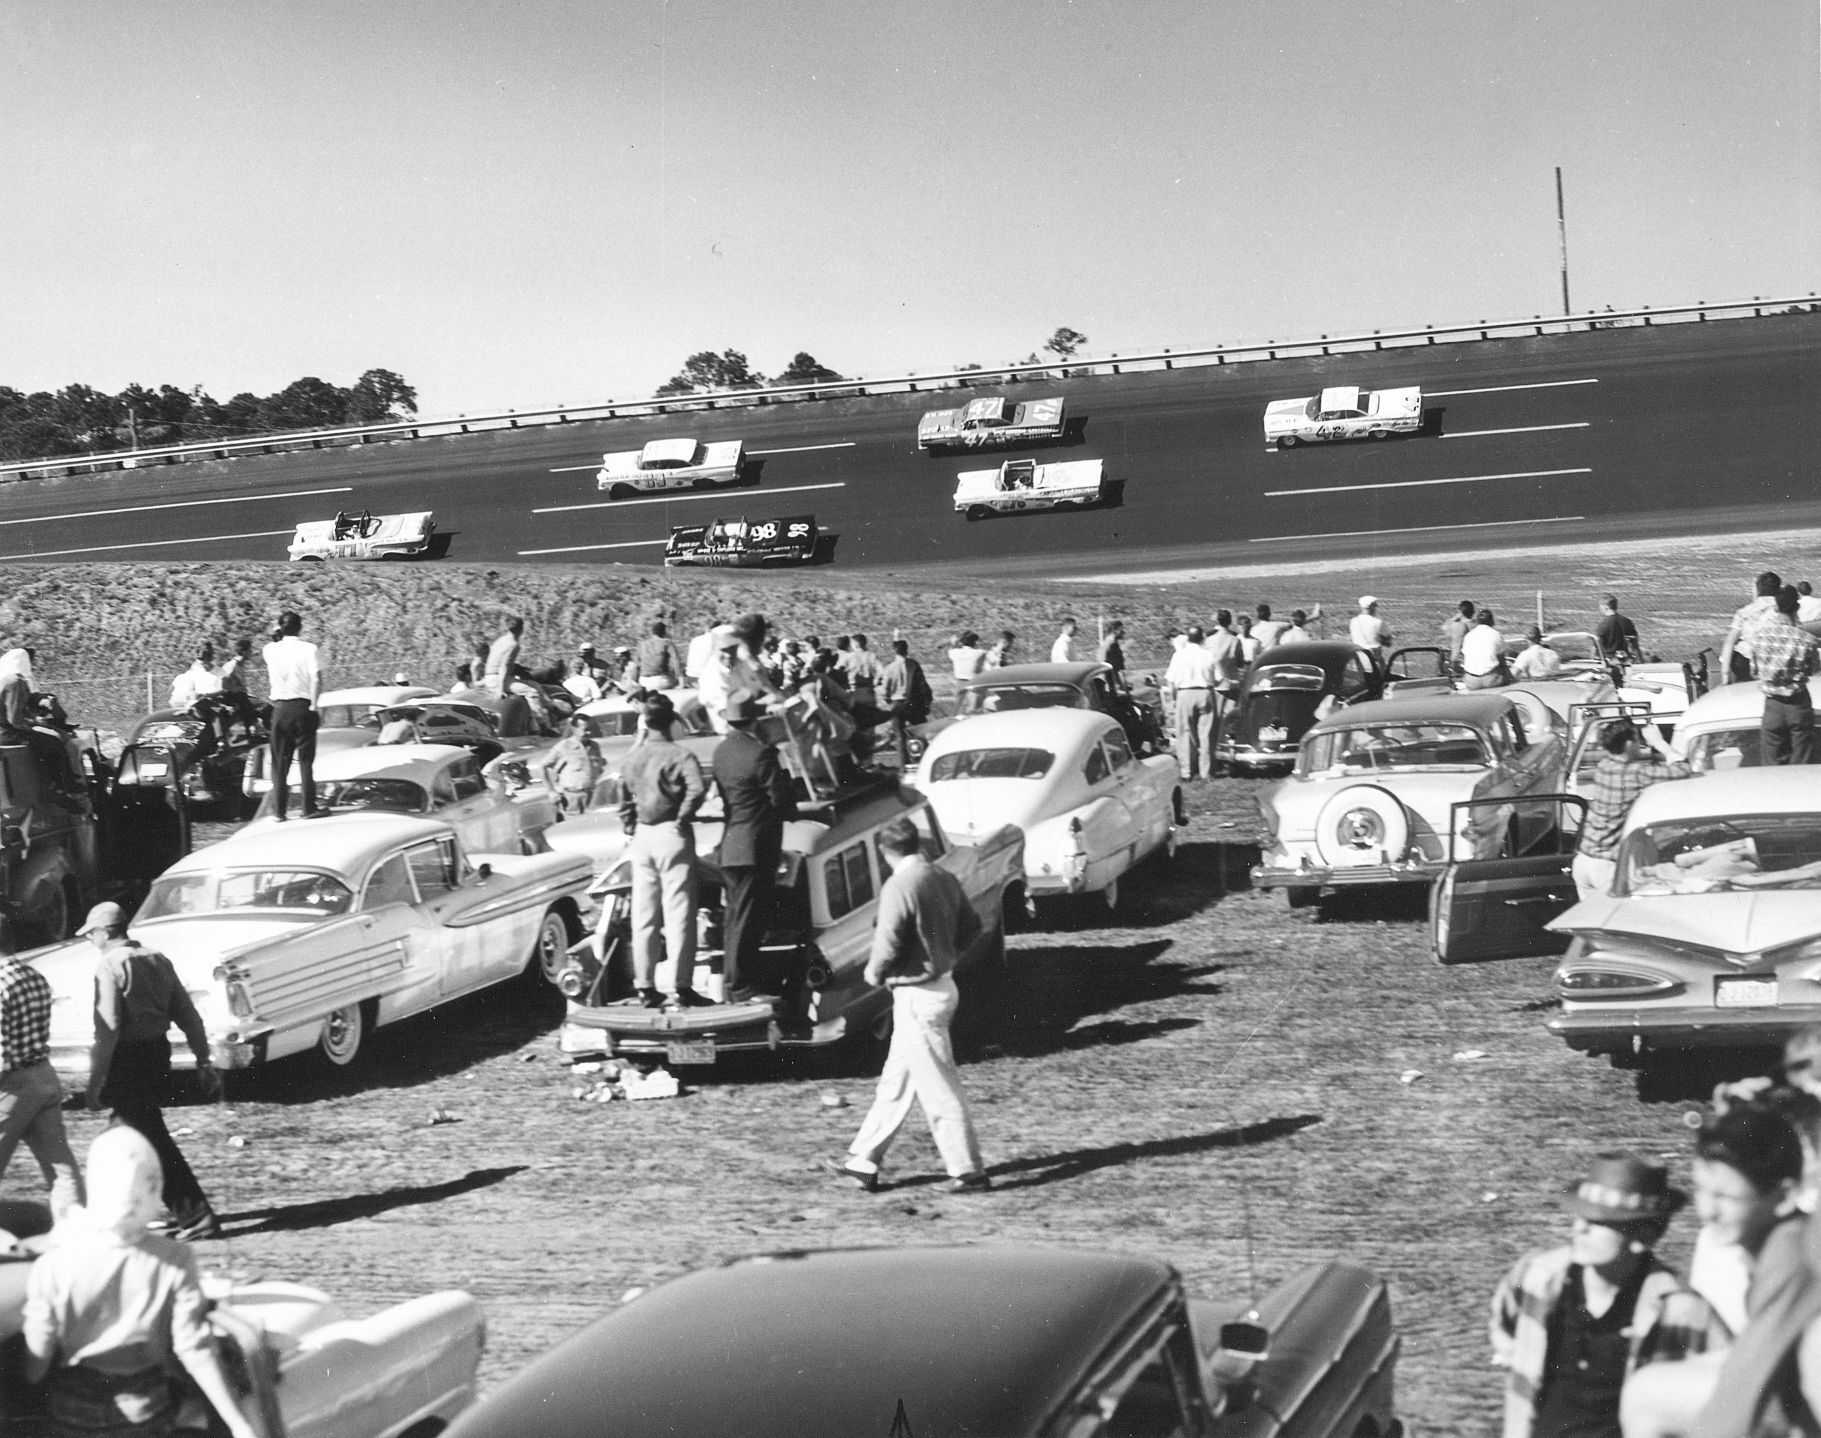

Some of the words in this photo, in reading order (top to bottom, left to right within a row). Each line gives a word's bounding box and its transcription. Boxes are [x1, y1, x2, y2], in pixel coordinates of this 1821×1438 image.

[969, 400, 999, 416] 47
[1033, 403, 1056, 421] 47
[1316, 424, 1346, 439] 42
[964, 432, 989, 447] 47
[751, 522, 777, 542] 98
[787, 523, 810, 537] 98
